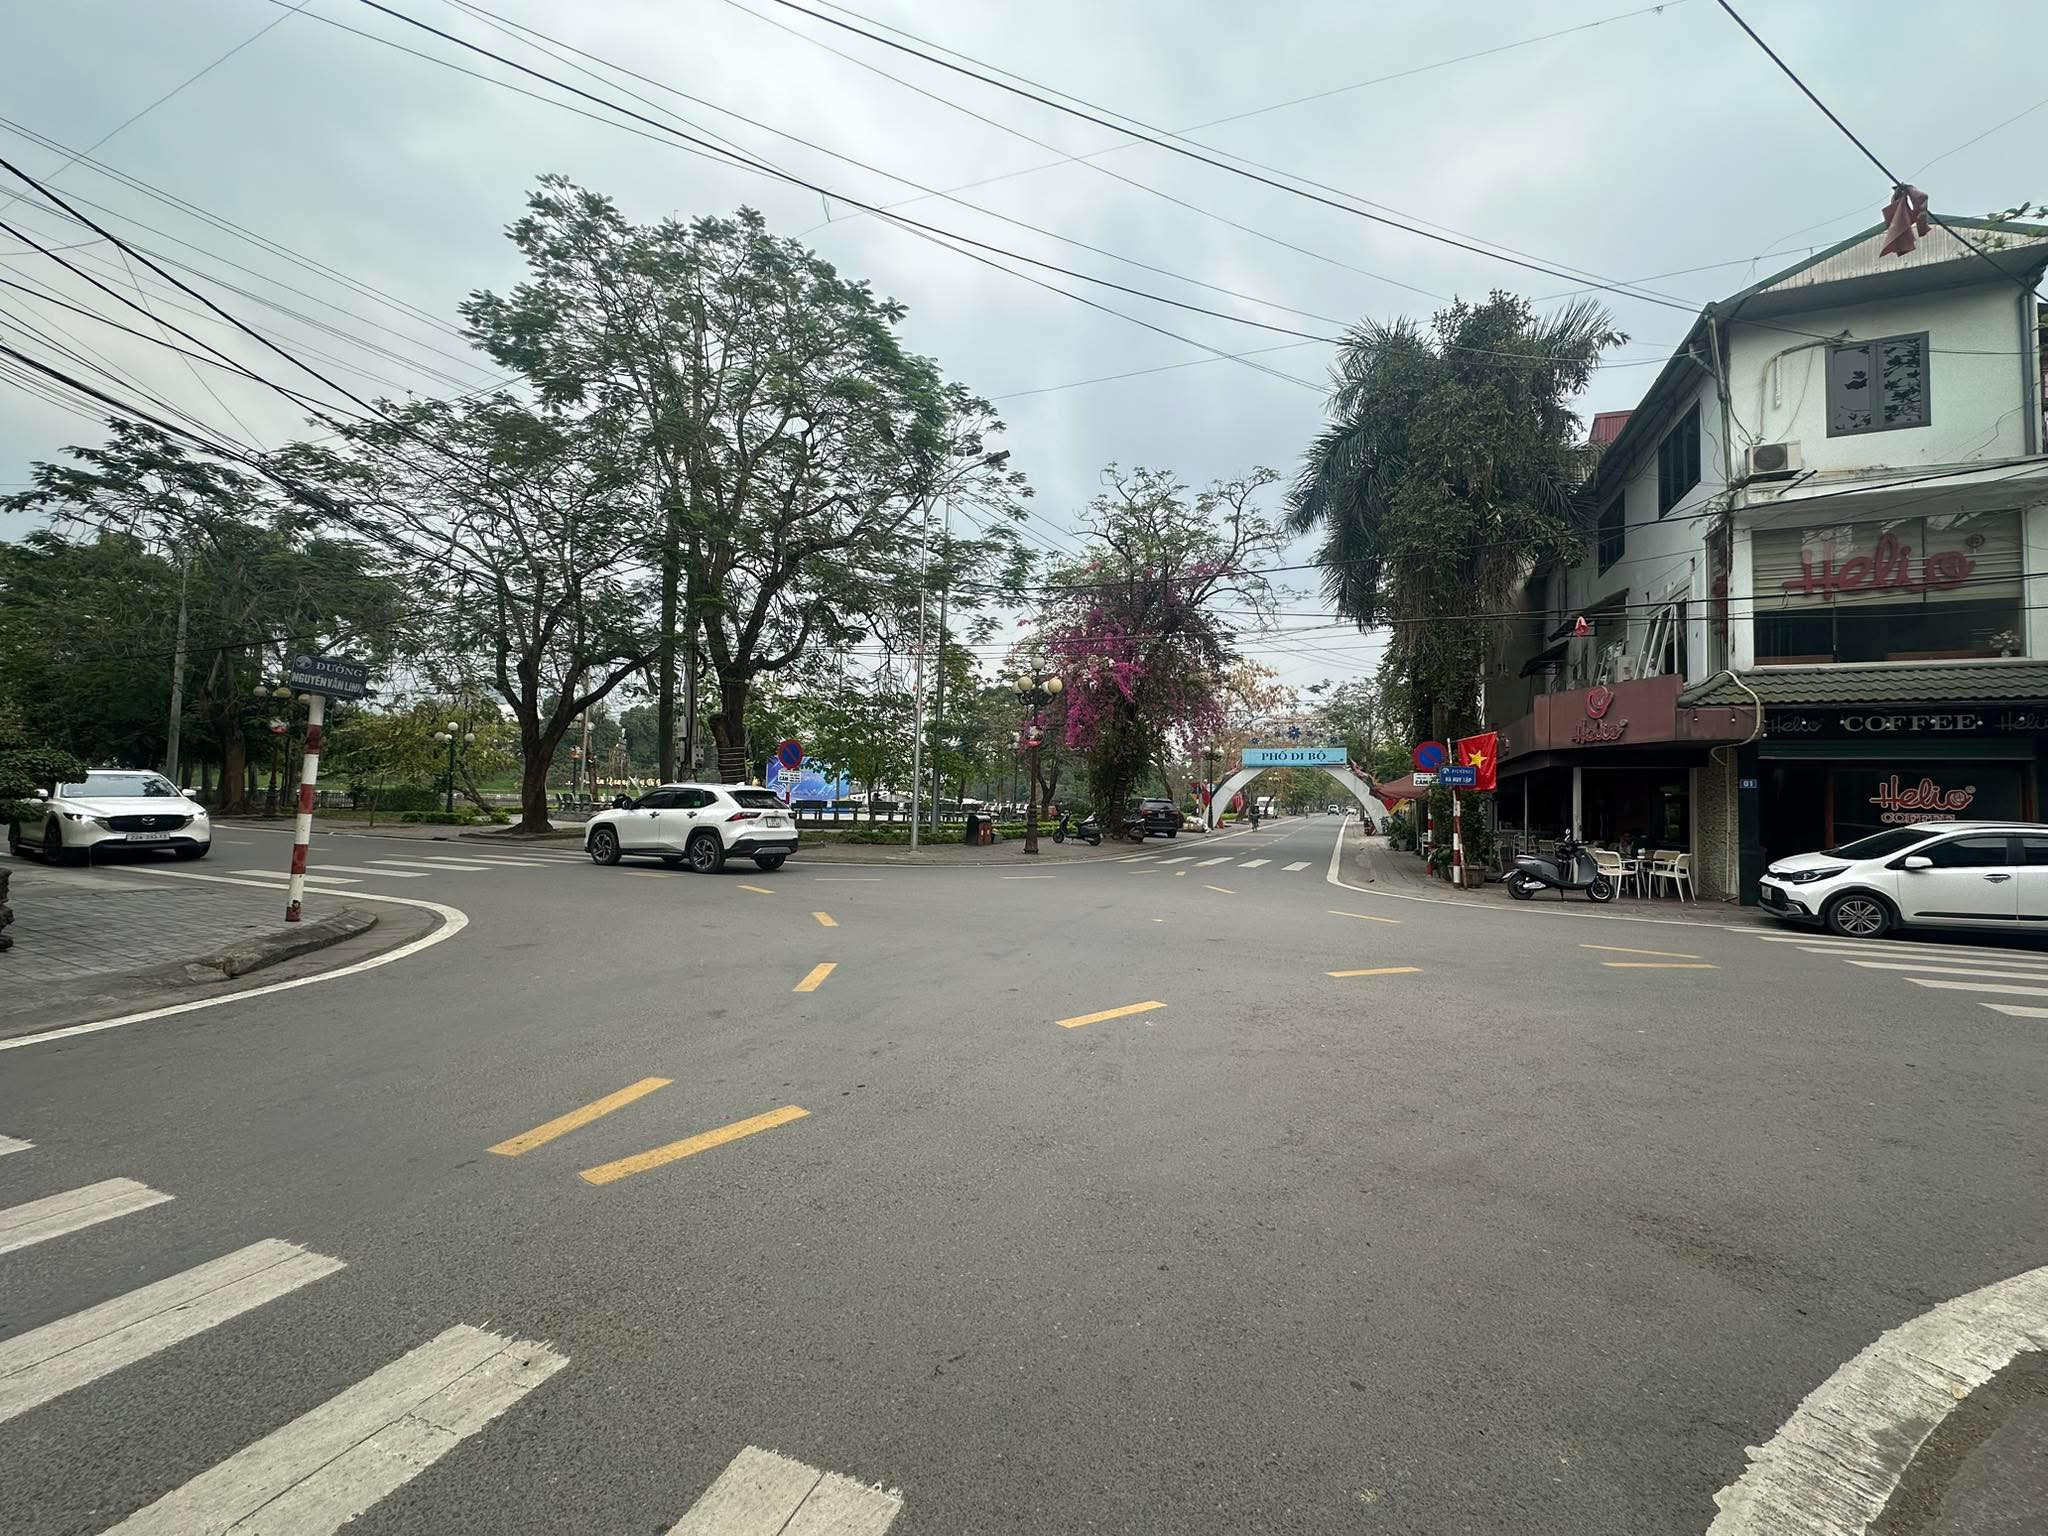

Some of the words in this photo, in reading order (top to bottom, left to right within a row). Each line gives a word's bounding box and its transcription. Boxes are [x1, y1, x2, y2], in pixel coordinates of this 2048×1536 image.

[1782, 532, 1976, 601] Helio
[326, 677, 343, 690] VĂN
[344, 682, 365, 694] LINH
[1569, 719, 1625, 744] Helio
[1767, 714, 1821, 733] Helio
[1843, 714, 1977, 732] COFFEE
[1262, 749, 1288, 761] PHỐ
[1308, 750, 1327, 762] BỘ
[1869, 775, 1974, 811] Helio
